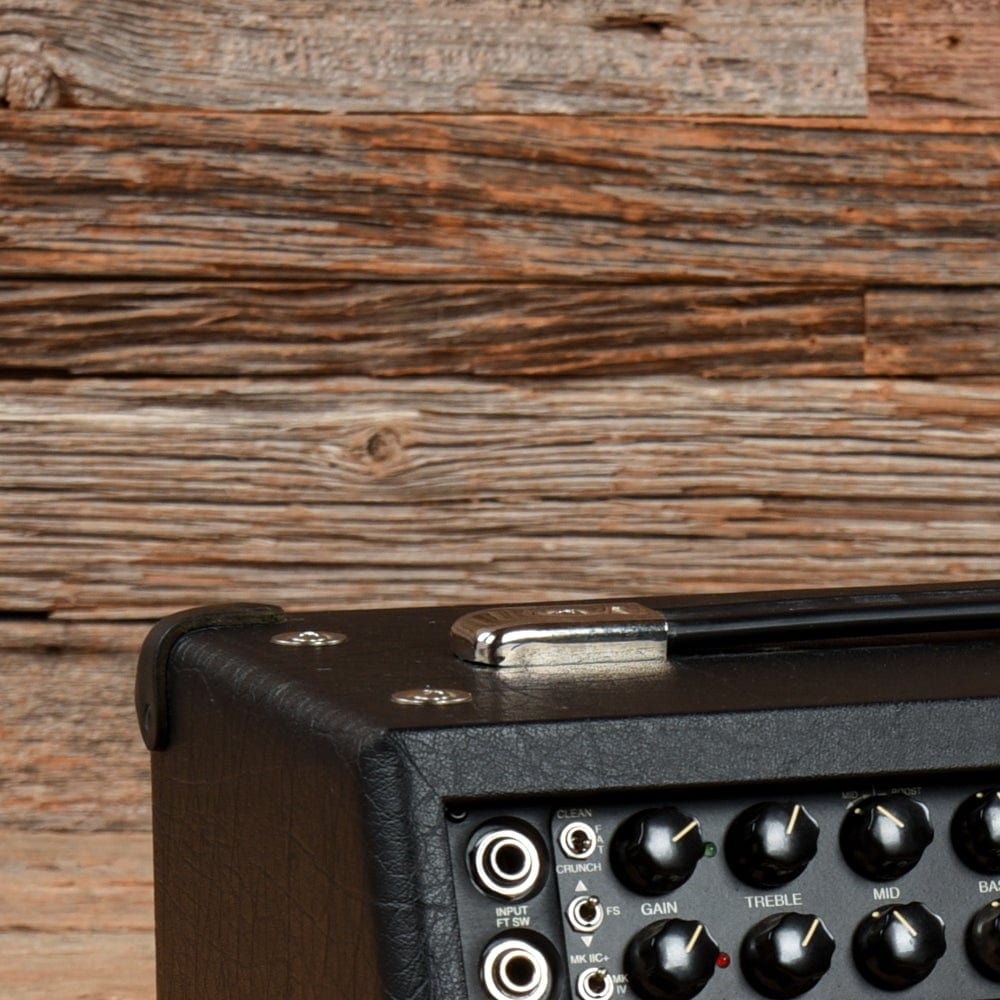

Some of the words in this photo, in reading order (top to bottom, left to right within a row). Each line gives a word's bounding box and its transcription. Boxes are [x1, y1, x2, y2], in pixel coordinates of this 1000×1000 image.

[556, 808, 592, 819] CLEAN
[556, 862, 602, 874] CRUNCH
[872, 886, 900, 900] MID
[744, 892, 803, 909] TREBLE
[495, 905, 528, 917] INPUT
[606, 906, 621, 916] FS
[640, 900, 678, 916] GAIN
[496, 918, 510, 928] FT
[512, 917, 531, 928] SW
[570, 954, 587, 965] MK
[588, 952, 610, 963] IIC+
[612, 974, 629, 984] MK
[616, 985, 628, 995] IV
